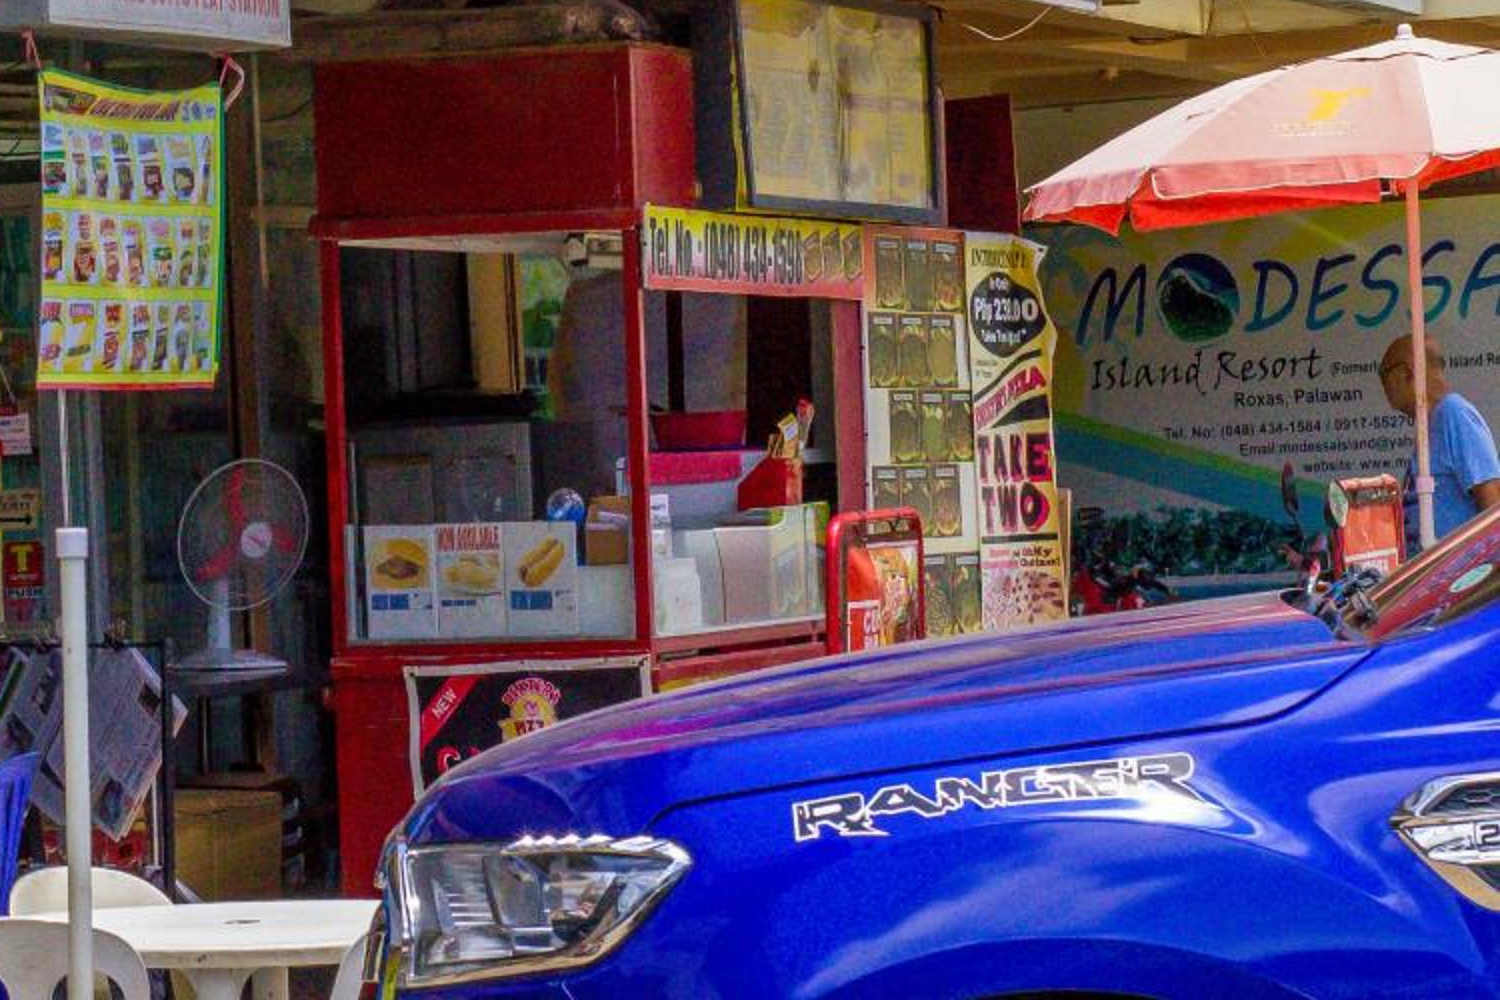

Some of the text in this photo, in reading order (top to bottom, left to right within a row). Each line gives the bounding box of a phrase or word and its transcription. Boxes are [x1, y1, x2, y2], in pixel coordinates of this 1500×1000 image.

[649, 217, 673, 277] Tel.
[1091, 348, 1206, 396] Island
[1212, 345, 1323, 390] Resort
[1234, 387, 1364, 409] Roxas, Palawan
[978, 432, 1054, 483] TAKE
[981, 481, 1051, 535] TWO
[431, 688, 457, 721] NEW
[792, 751, 1204, 843] RANGER
